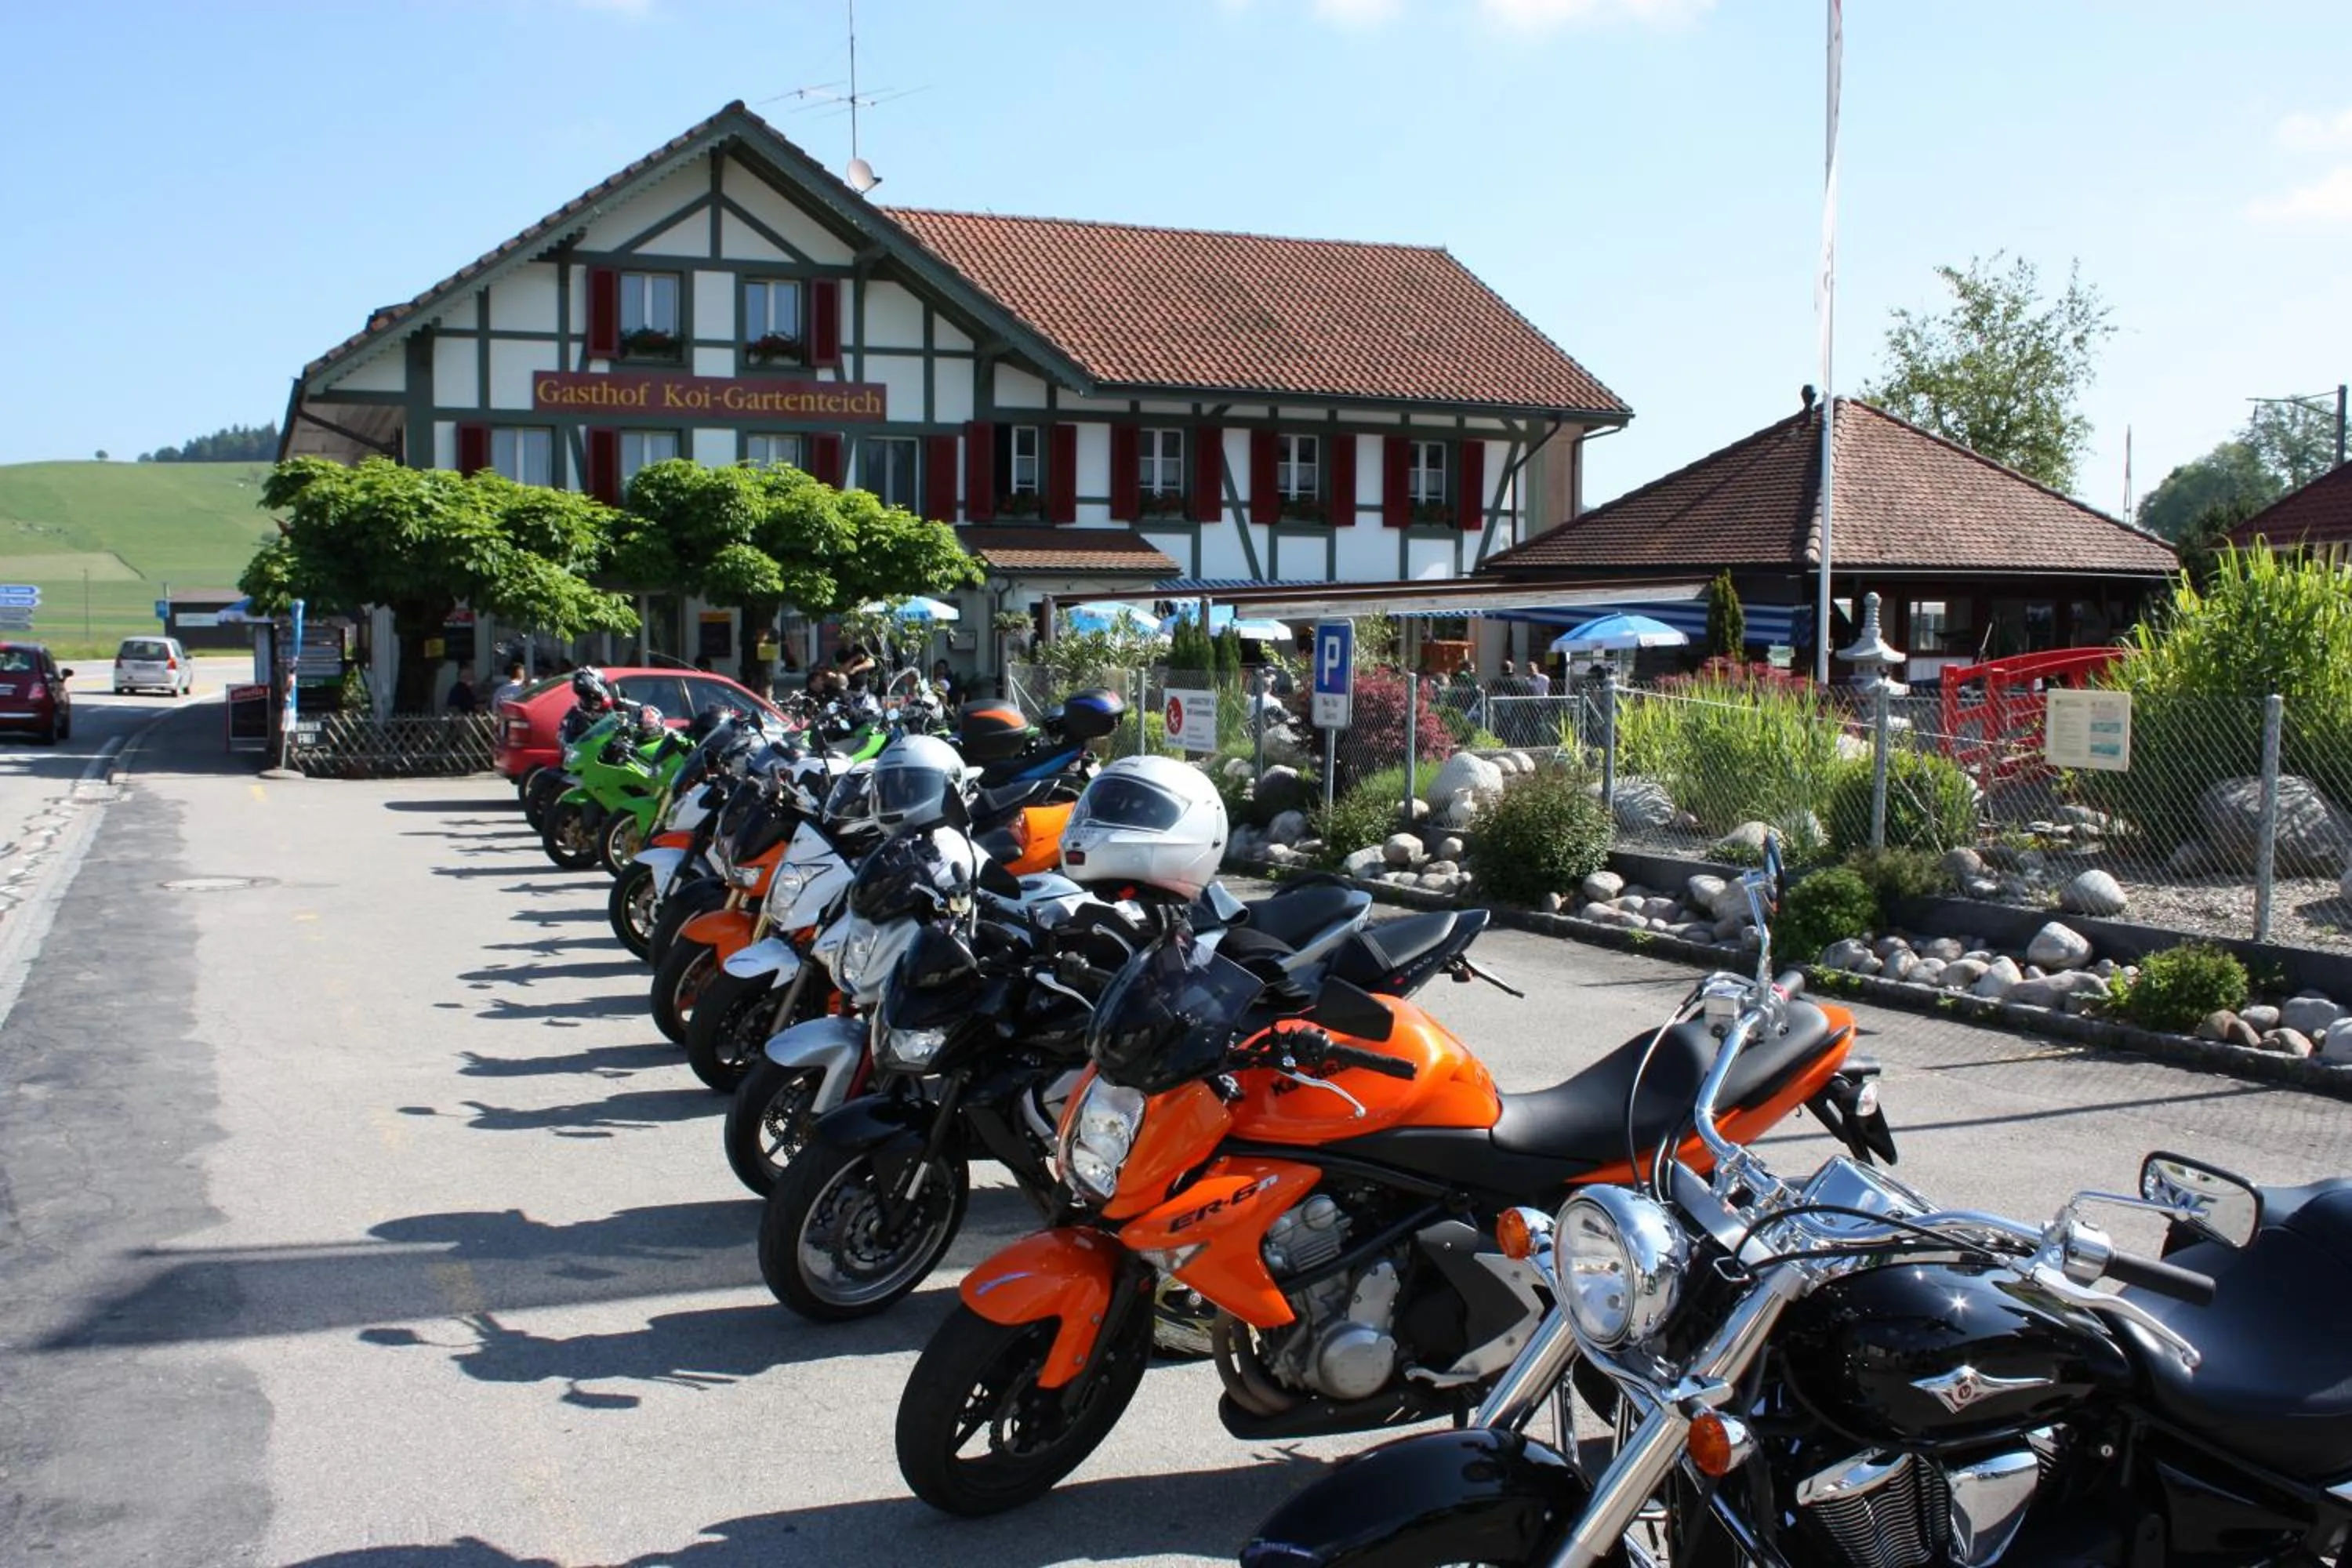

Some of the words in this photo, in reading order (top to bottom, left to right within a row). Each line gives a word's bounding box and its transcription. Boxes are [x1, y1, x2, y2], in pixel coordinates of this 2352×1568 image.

[537, 379, 650, 405] Gasthof
[662, 383, 881, 414] Koi-Gartenteich
[1324, 636, 1340, 685] P
[1169, 1174, 1279, 1233] ER-6n
